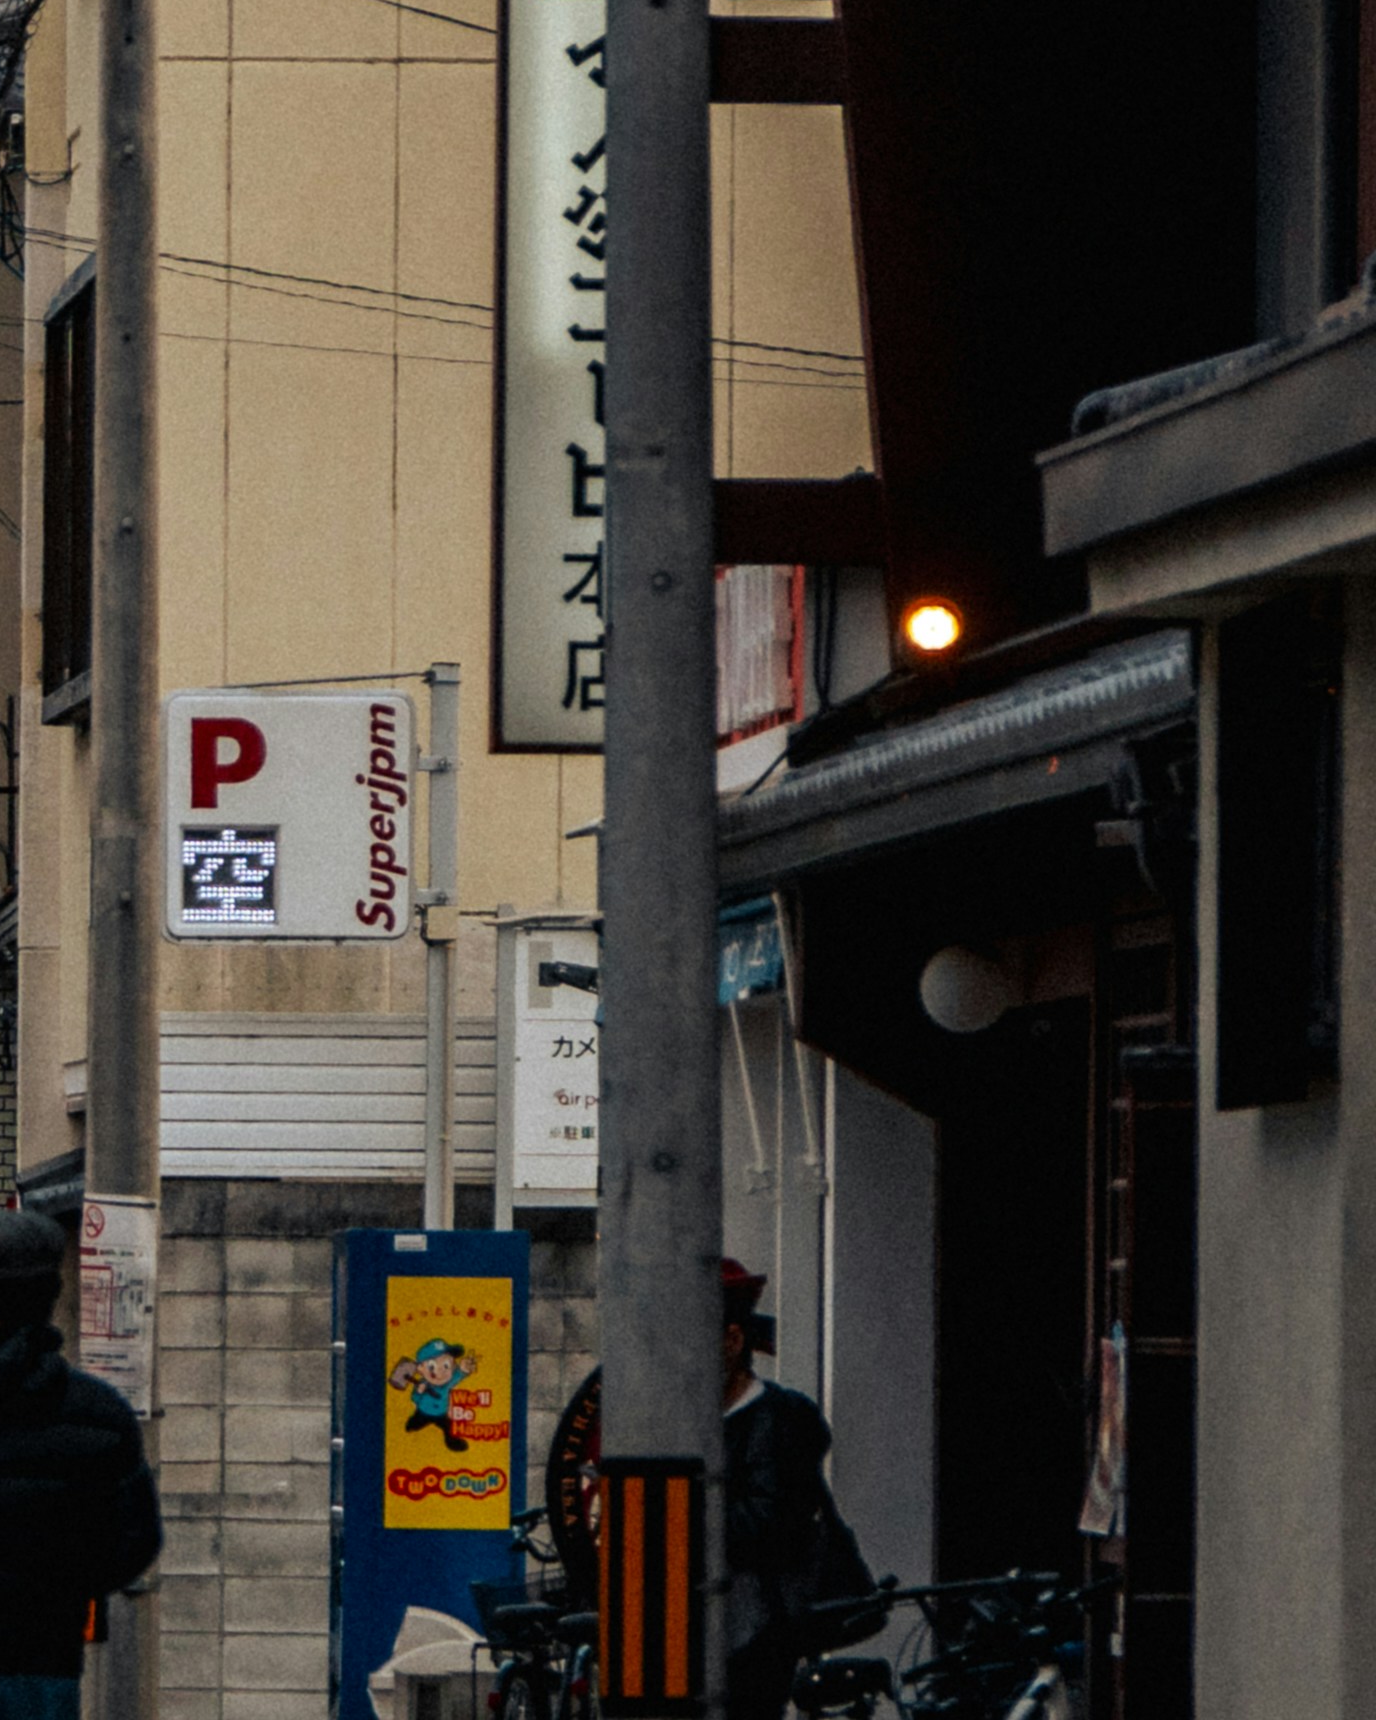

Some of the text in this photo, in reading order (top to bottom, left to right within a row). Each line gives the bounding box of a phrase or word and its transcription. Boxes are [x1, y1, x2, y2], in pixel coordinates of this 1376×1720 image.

[190, 716, 268, 809] P
[355, 702, 408, 932] Superjpm
[182, 829, 276, 922] 空
[452, 1406, 474, 1422] Be
[396, 1471, 500, 1496] TWO DOWN
